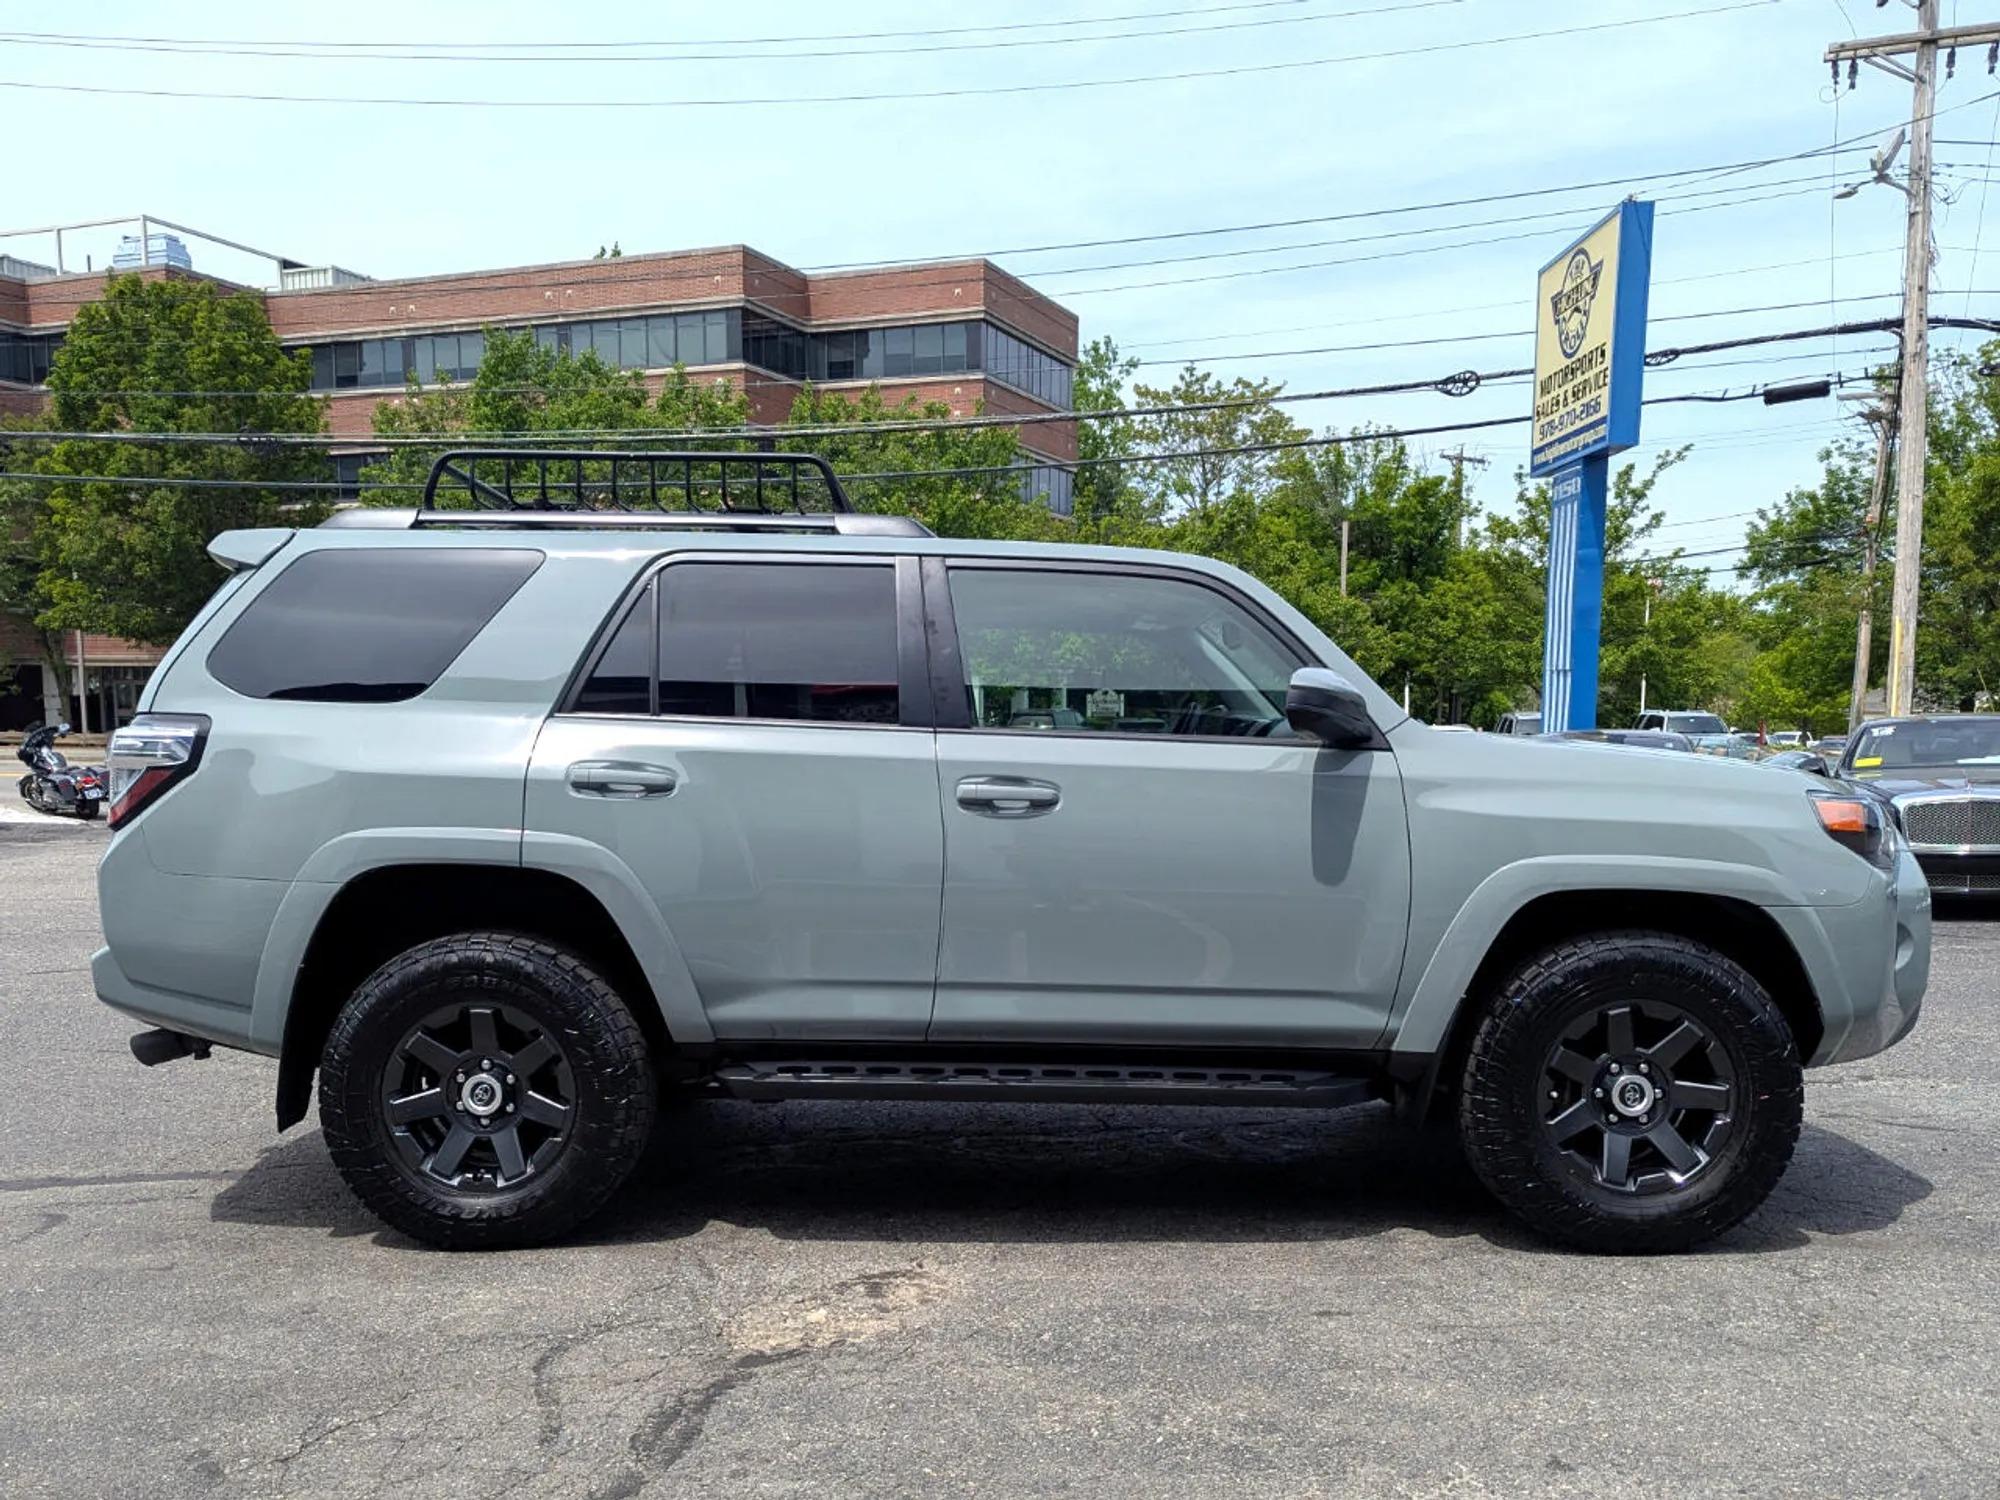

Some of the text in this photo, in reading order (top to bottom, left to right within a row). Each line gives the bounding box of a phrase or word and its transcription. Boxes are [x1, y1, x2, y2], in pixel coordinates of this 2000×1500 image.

[1536, 366, 1609, 423] SALES & SERVICE
[1540, 343, 1607, 398] MOTORSPORTS
